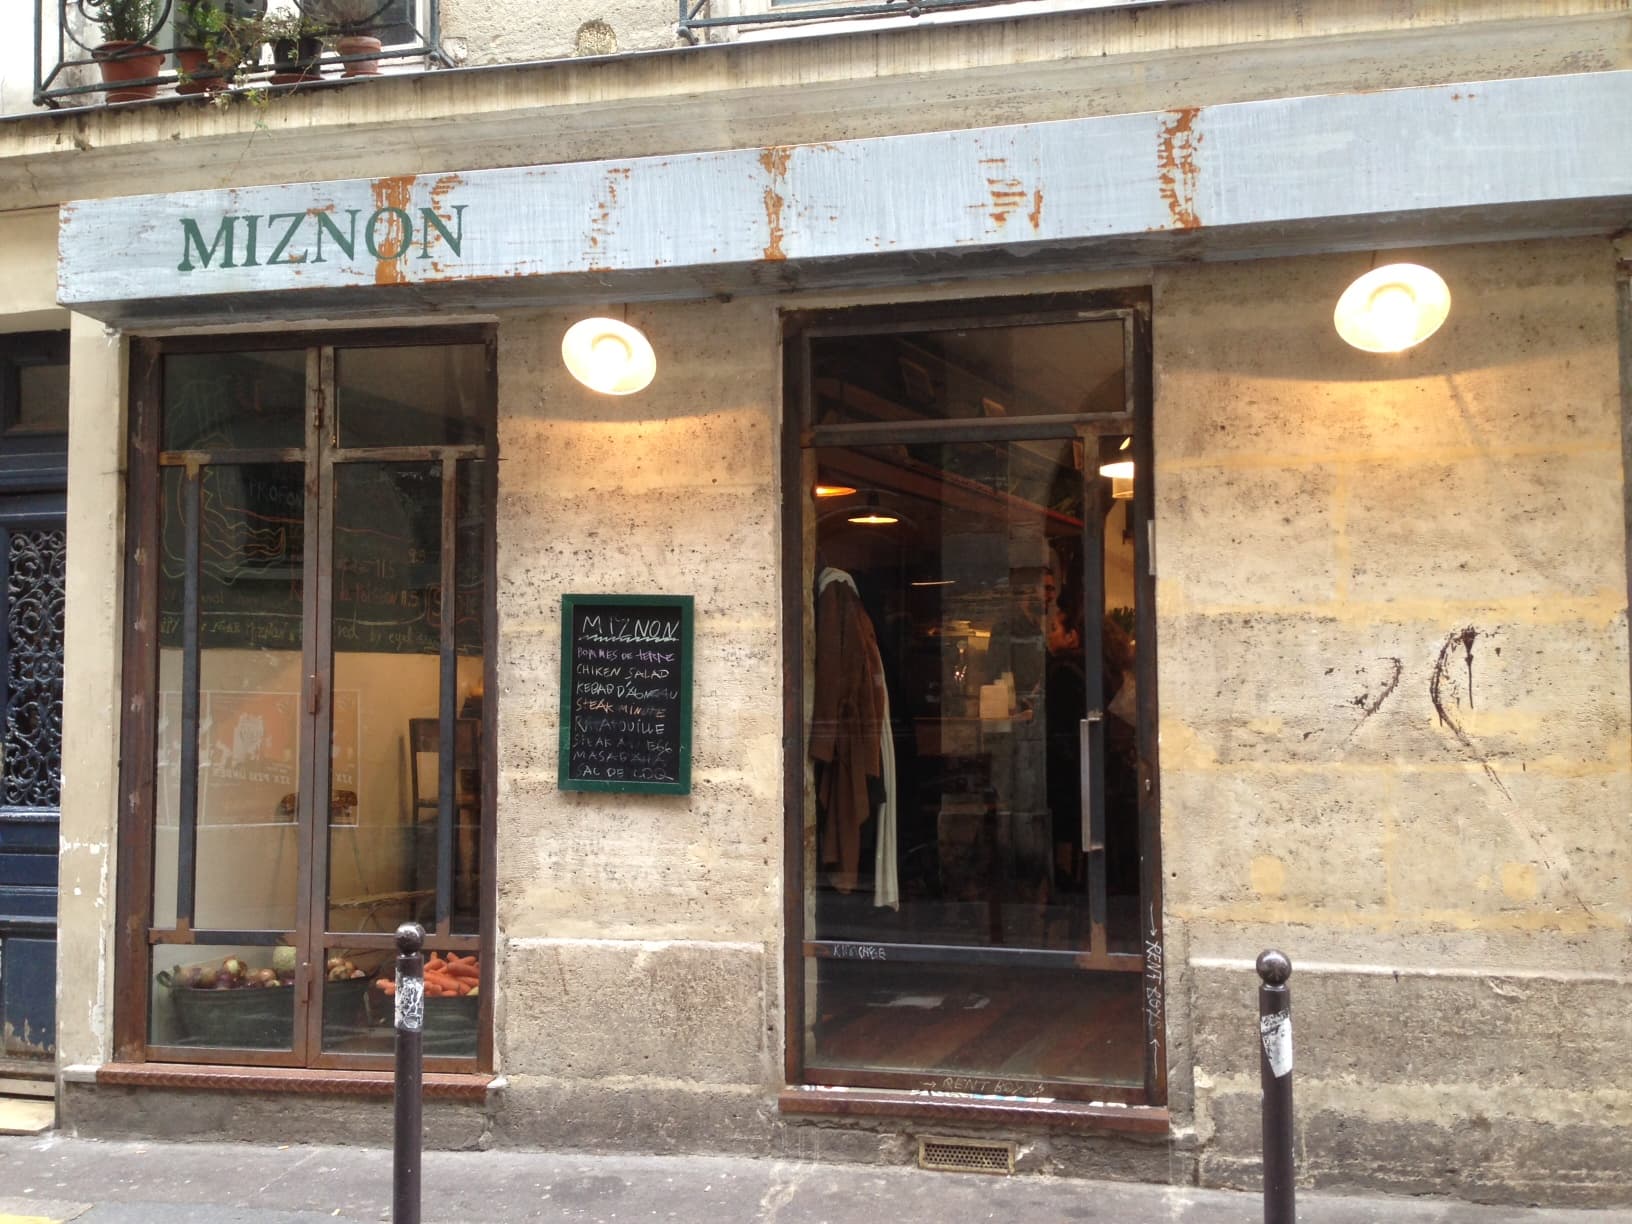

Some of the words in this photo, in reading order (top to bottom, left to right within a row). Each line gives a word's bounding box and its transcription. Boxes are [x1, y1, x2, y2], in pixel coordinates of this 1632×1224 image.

[177, 205, 469, 272] MIZNON
[582, 615, 680, 638] MIZNON
[577, 663, 621, 677] CHIKEN
[624, 667, 670, 680] SALAD
[576, 680, 615, 695] KEBAB
[606, 767, 625, 778] DE
